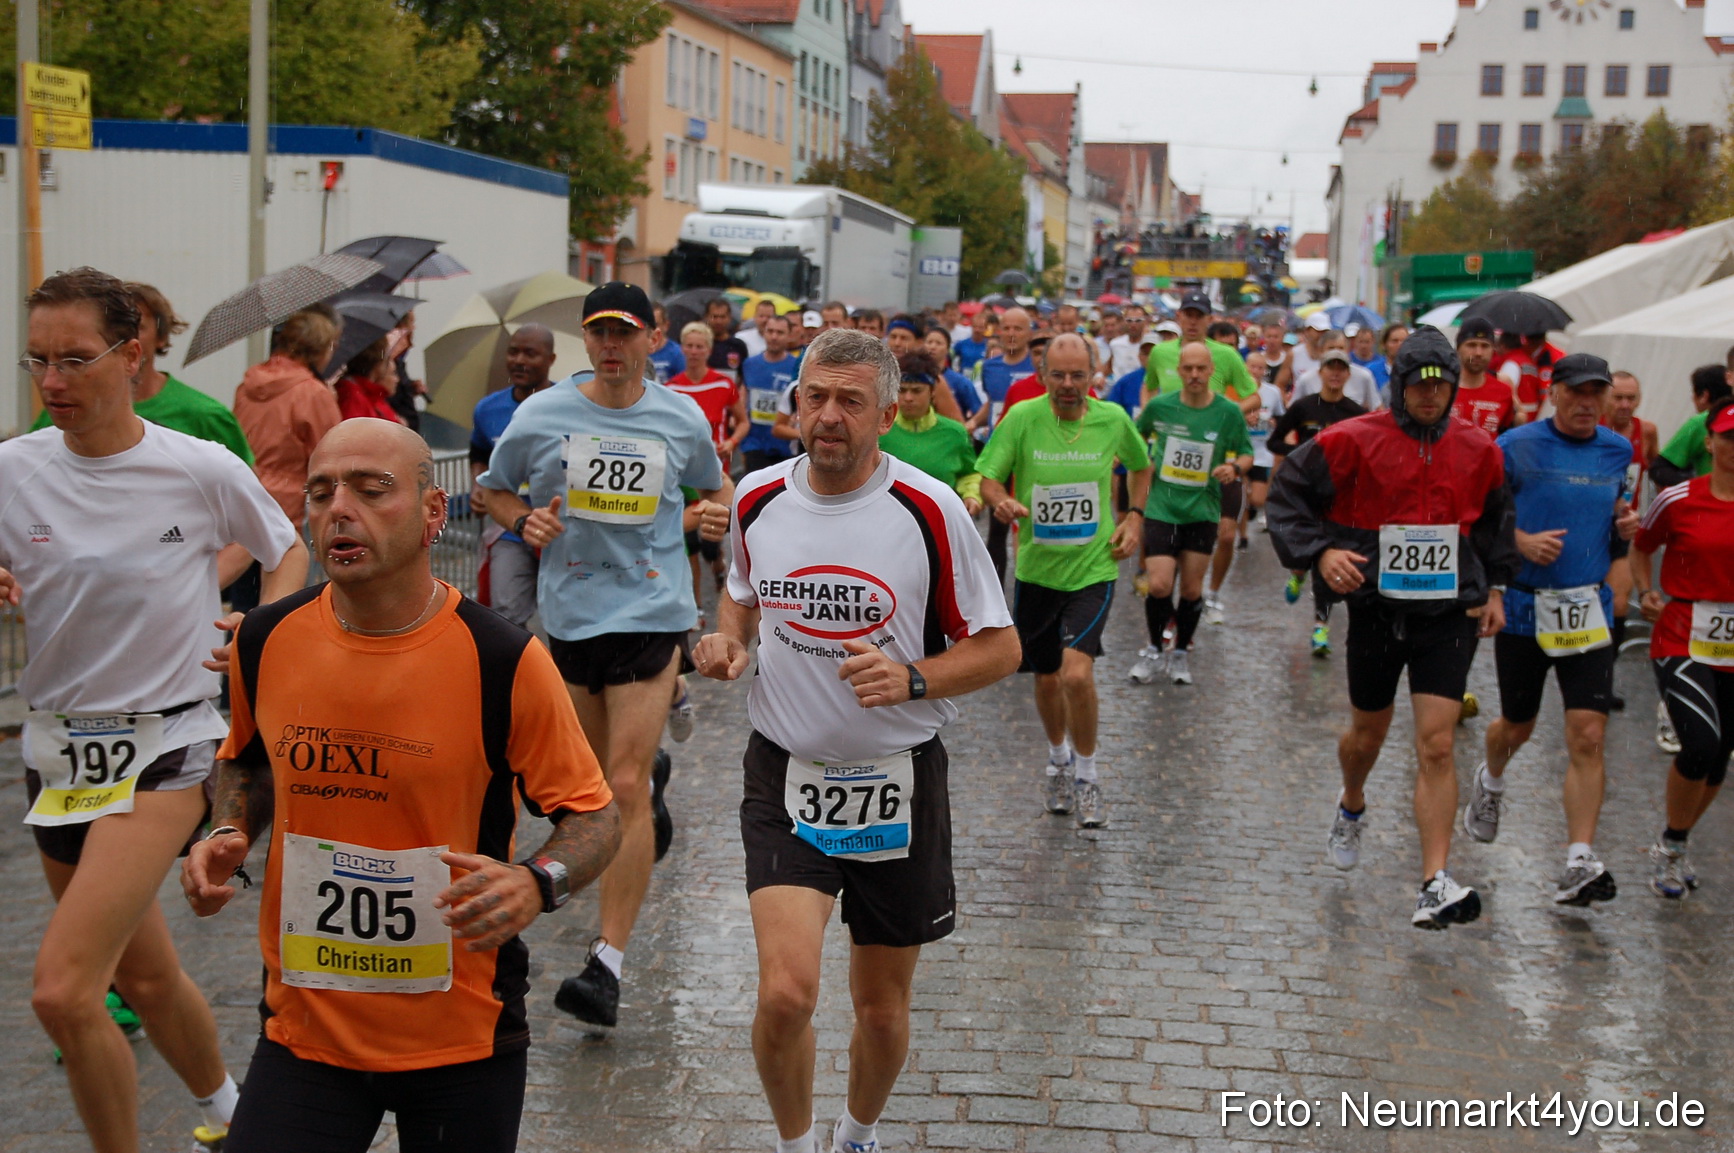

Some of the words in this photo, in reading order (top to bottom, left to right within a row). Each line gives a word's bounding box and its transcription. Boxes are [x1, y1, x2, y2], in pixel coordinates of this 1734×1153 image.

[1172, 450, 1204, 471] 383
[587, 458, 646, 493] 282
[589, 495, 639, 512] Manfred
[1037, 498, 1093, 523] 3279
[1388, 544, 1451, 572] 2842
[759, 579, 866, 603] GERHART
[869, 592, 879, 602] &
[1402, 577, 1438, 588] Robert
[761, 600, 803, 611] Autohaus
[801, 602, 882, 623] JÄNIG
[1551, 605, 1590, 630] 167
[773, 626, 790, 646] Das
[791, 640, 846, 659] sportliche
[69, 716, 119, 730] BOCK
[333, 732, 365, 742] UHREN
[366, 735, 386, 746] UND
[387, 739, 434, 756] SCHMUCK
[60, 740, 136, 785] 192
[289, 741, 389, 779] OEXL
[290, 783, 321, 796] CIBA
[339, 787, 389, 802] VISION
[798, 783, 901, 826] 3276
[816, 832, 884, 850] Hermann
[333, 852, 396, 875] BOCK
[316, 880, 416, 942] 205
[317, 945, 412, 973] Christian
